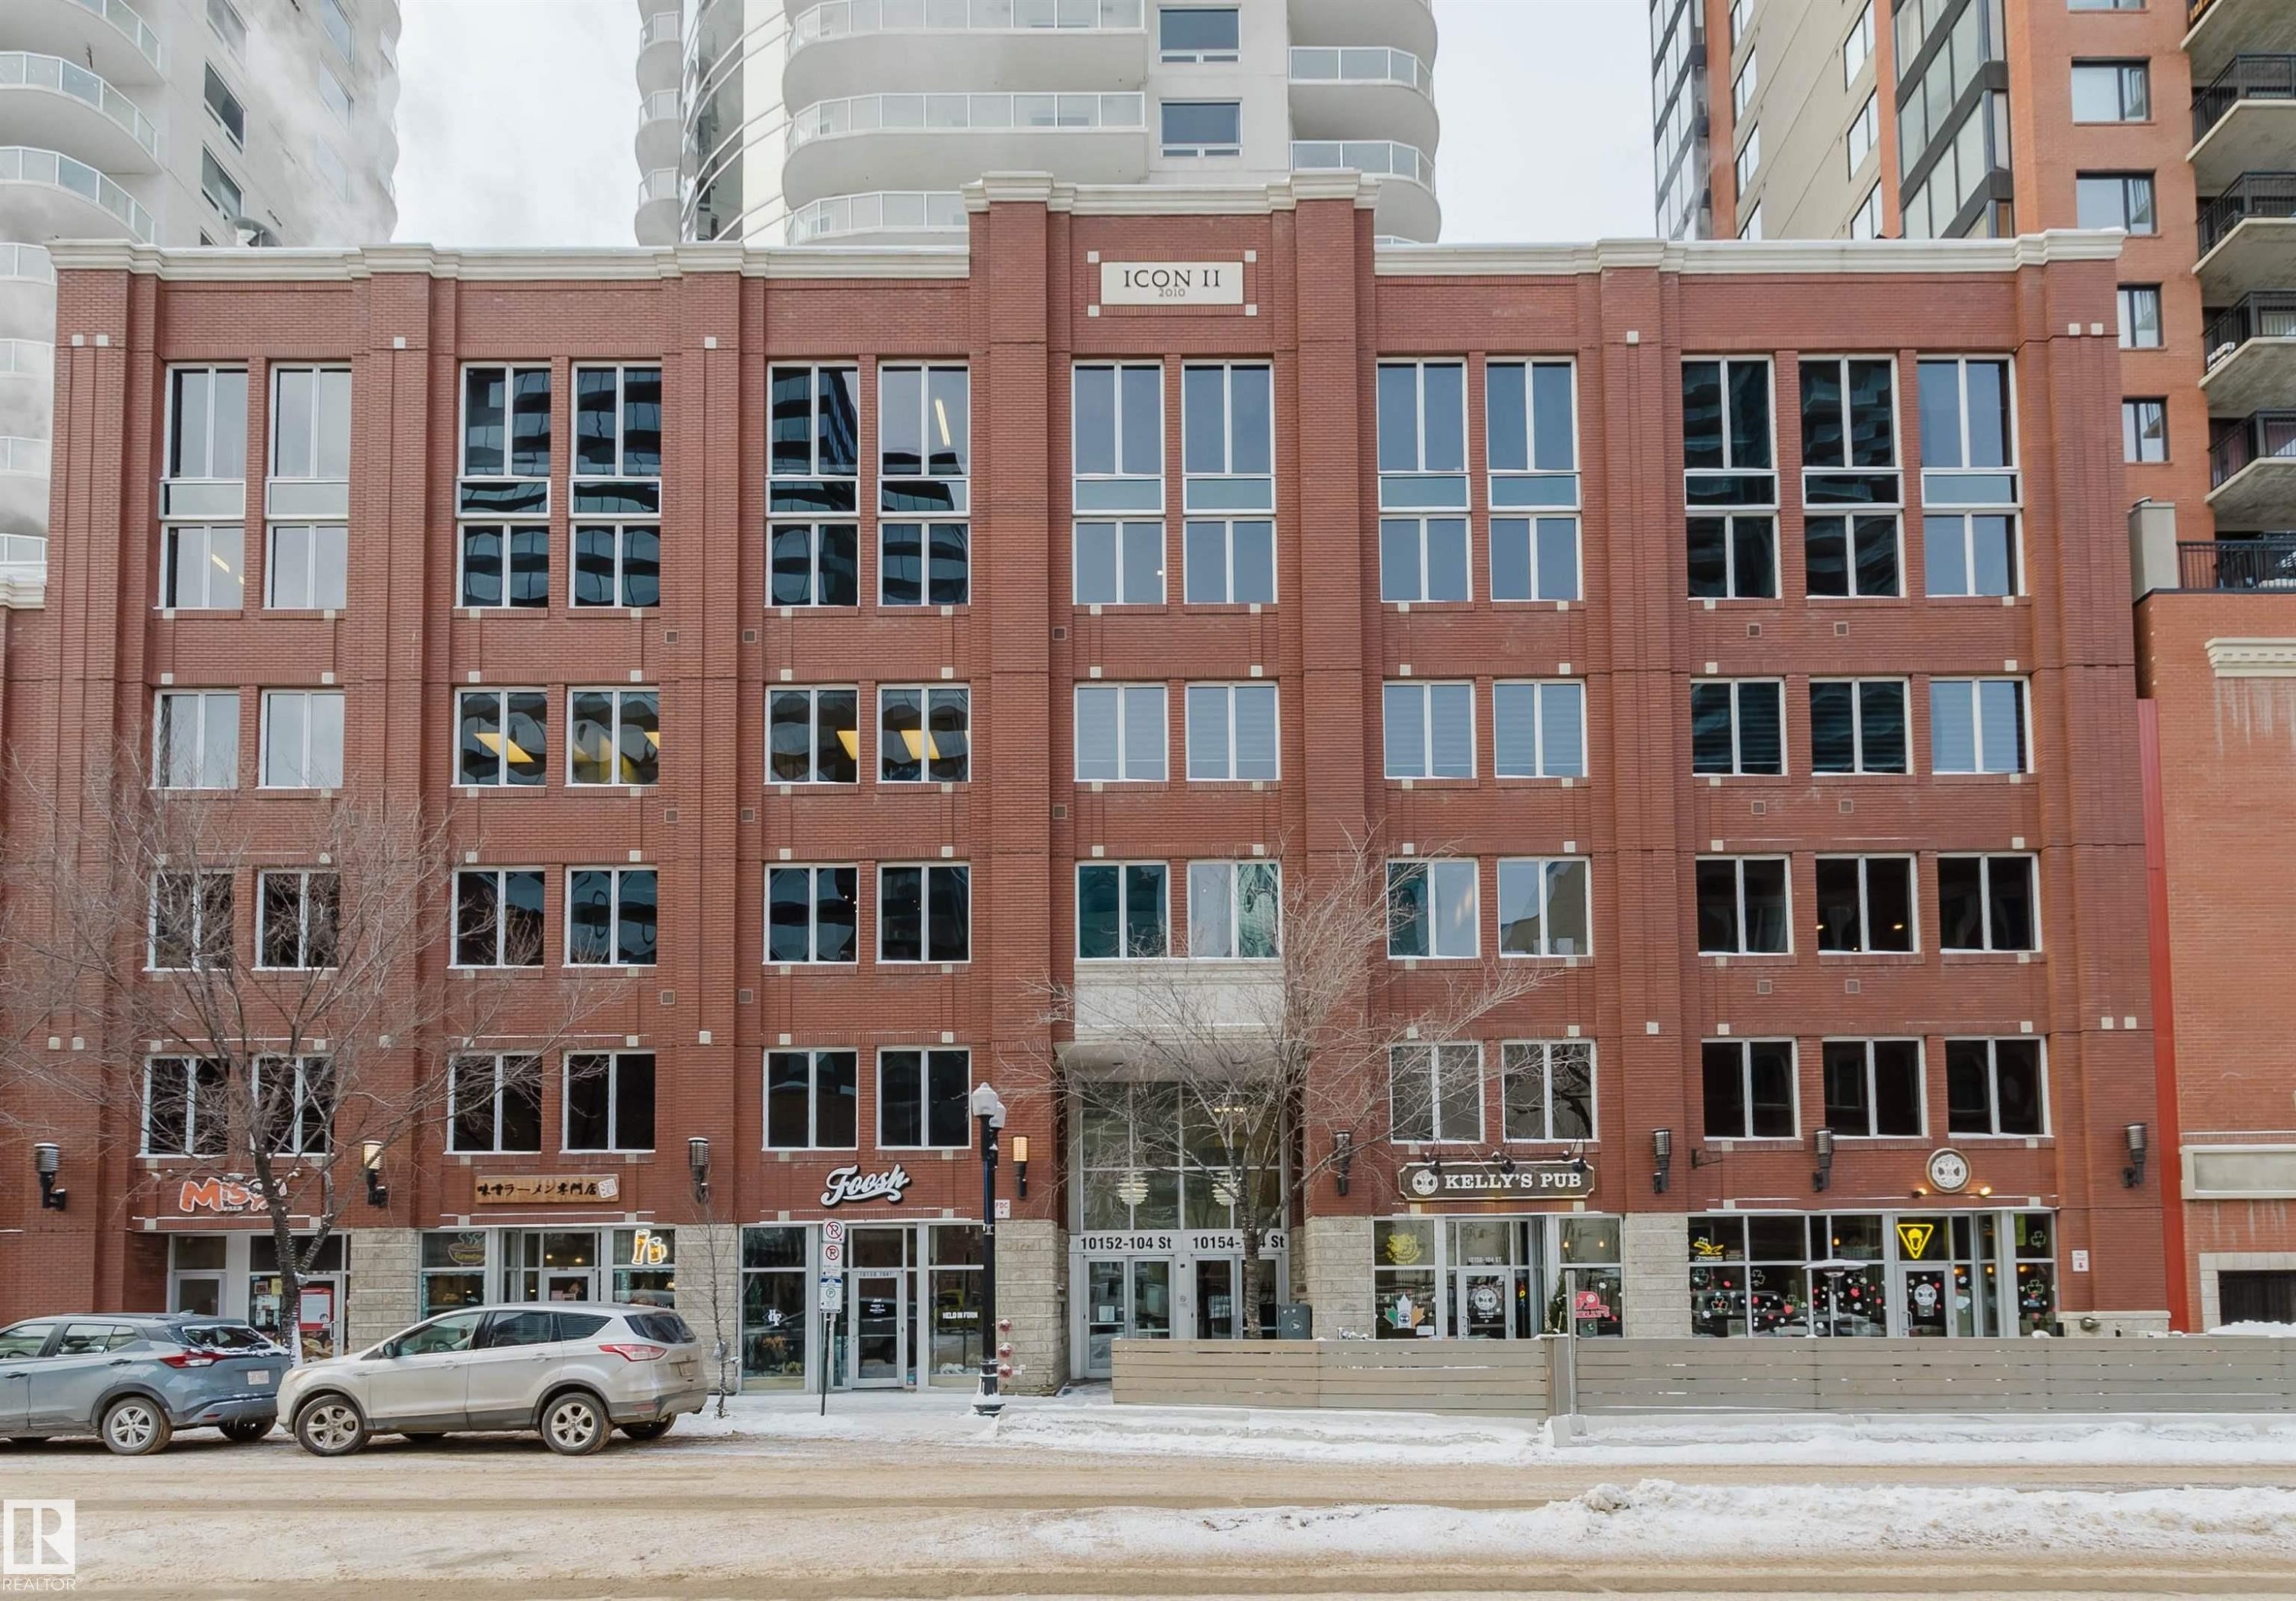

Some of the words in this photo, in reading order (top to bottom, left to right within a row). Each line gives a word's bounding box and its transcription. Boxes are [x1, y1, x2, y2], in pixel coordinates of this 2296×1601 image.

[1124, 269, 1191, 288] ICON
[1202, 269, 1221, 288] II
[1158, 288, 1186, 298] 2010
[820, 1163, 910, 1207] Foosh
[1444, 1173, 1533, 1189] KELLY'S
[1540, 1172, 1582, 1189] PUB
[1080, 1237, 1153, 1250] 10152-104
[1158, 1237, 1172, 1250] St
[1270, 1235, 1285, 1248] St
